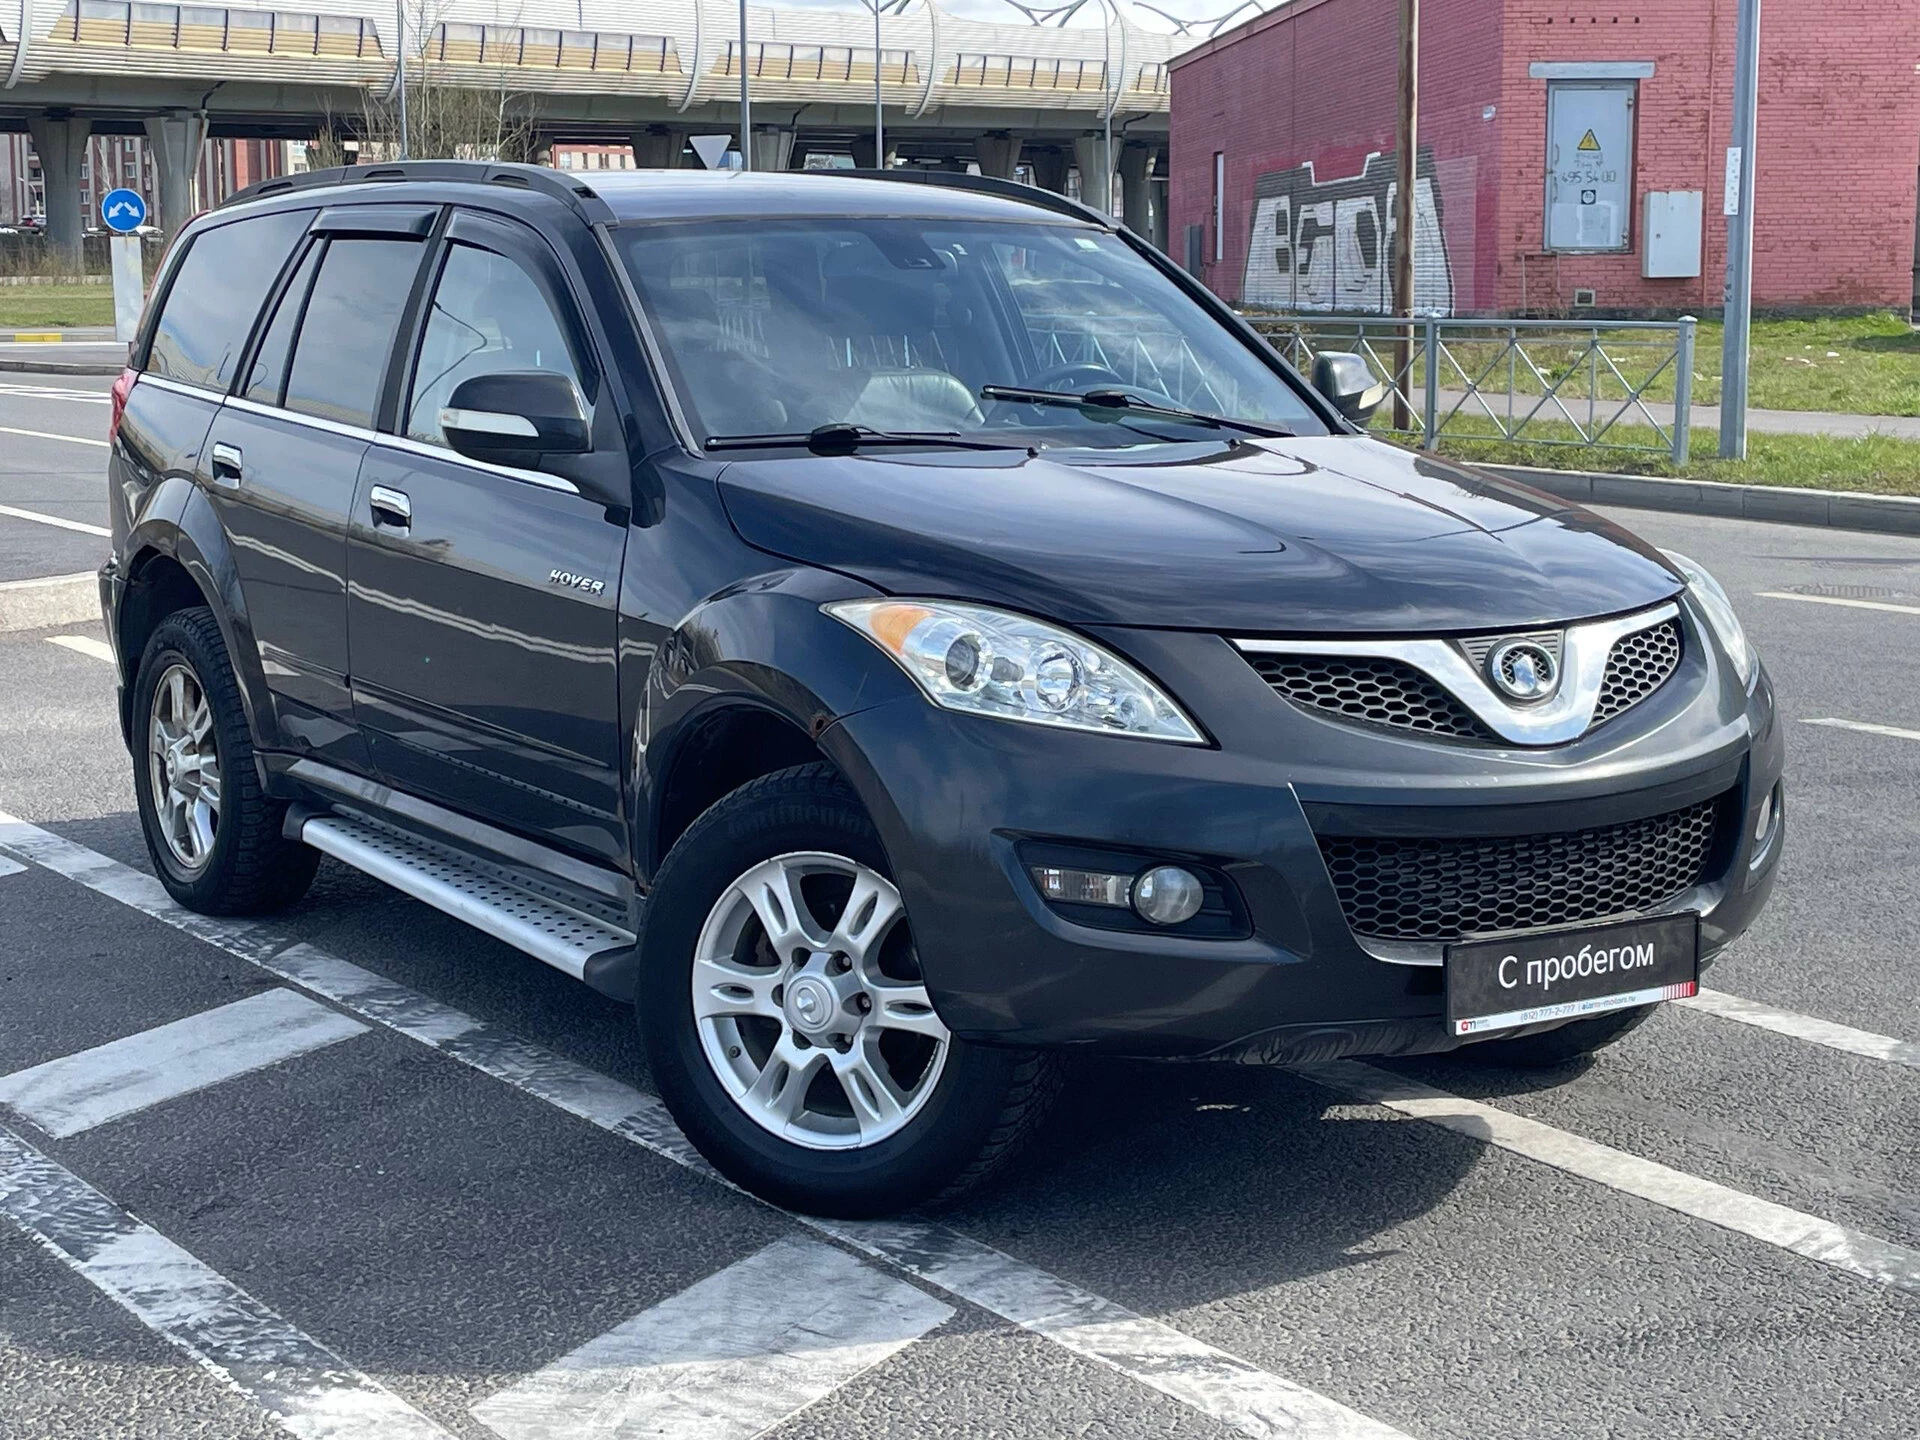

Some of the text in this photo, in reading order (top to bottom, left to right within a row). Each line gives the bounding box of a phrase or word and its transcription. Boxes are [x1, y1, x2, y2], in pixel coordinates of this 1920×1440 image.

[549, 568, 605, 595] HOVER
[1498, 942, 1655, 990] С пробегом
